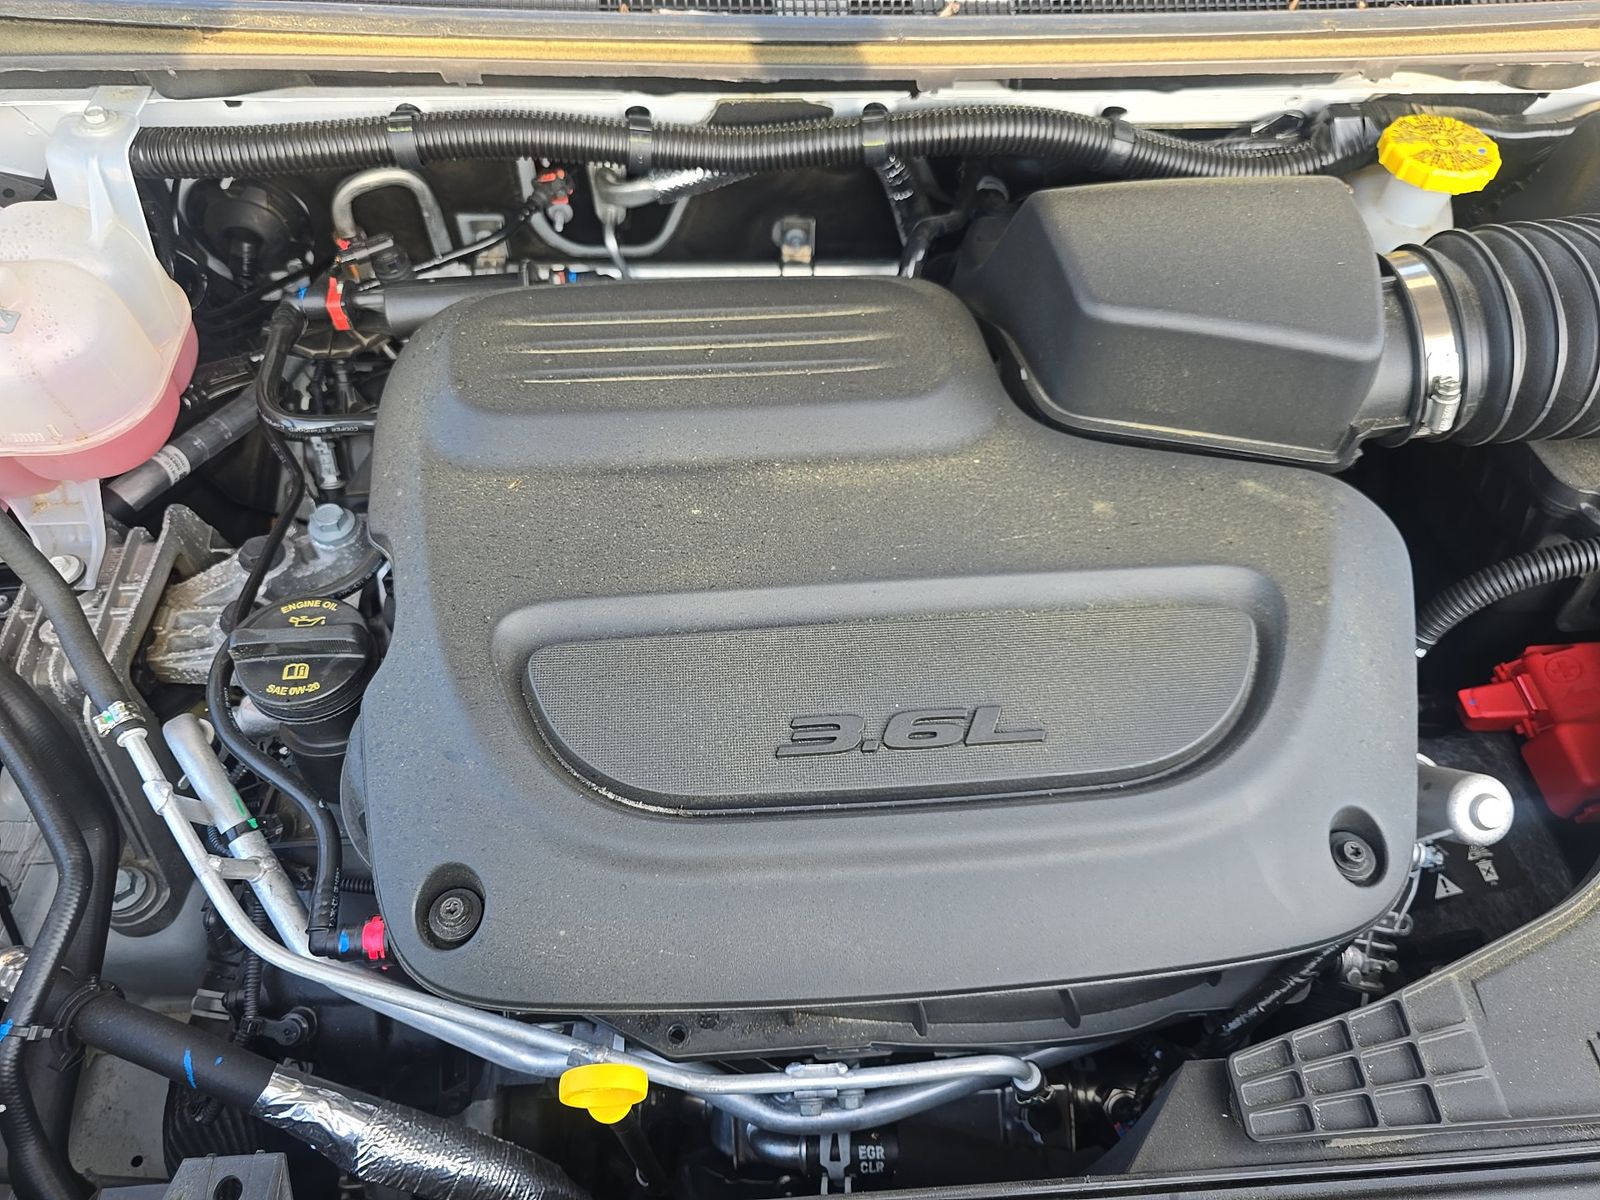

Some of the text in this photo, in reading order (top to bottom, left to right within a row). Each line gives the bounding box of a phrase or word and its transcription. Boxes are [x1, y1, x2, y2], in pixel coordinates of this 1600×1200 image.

[281, 600, 338, 614] ENGINE OIL
[266, 682, 320, 696] SAE 0W-20
[775, 705, 1047, 758] 3.6L
[858, 1144, 885, 1160] EGR
[860, 1161, 885, 1174] CLR
